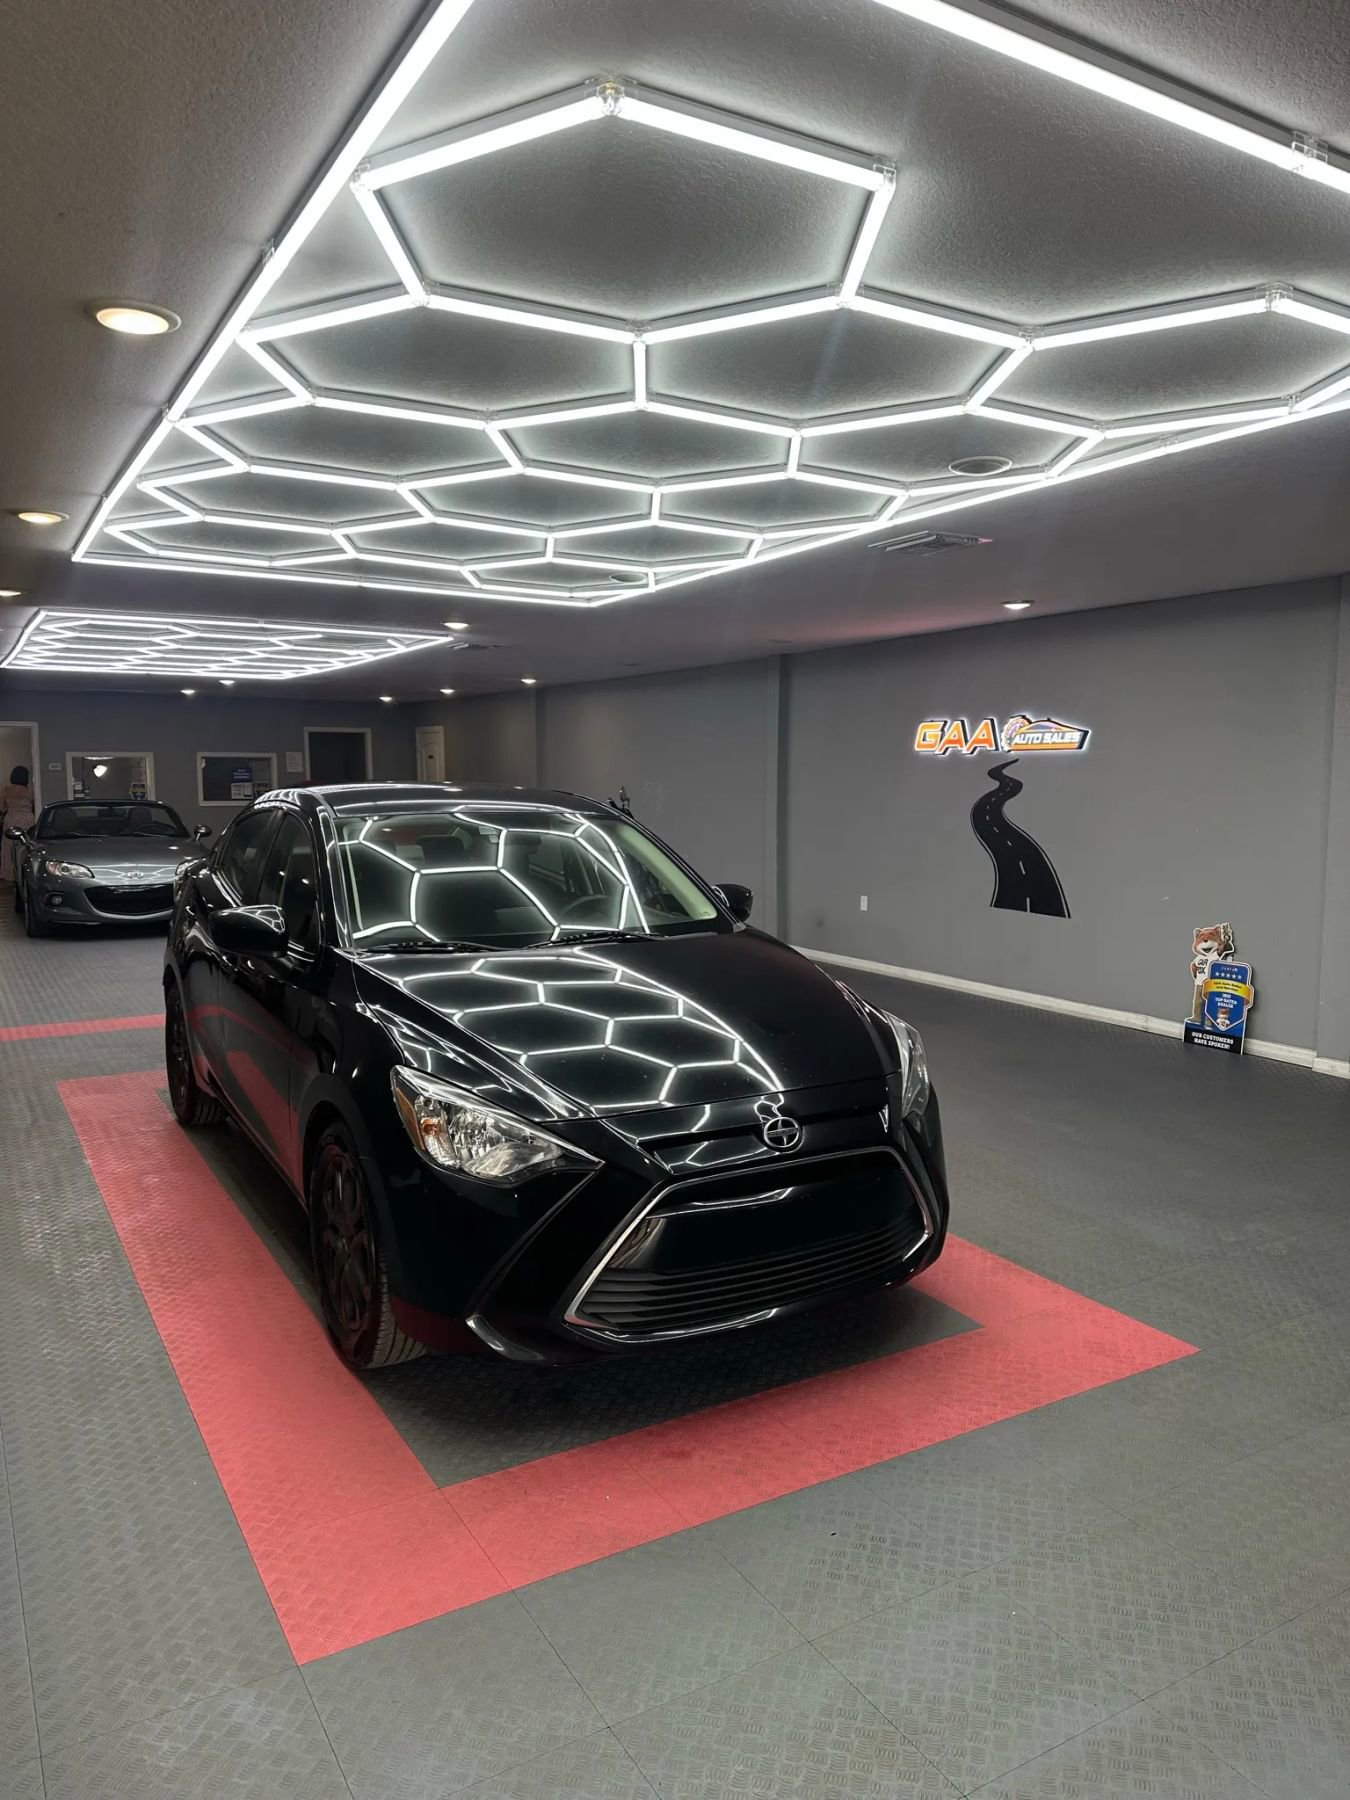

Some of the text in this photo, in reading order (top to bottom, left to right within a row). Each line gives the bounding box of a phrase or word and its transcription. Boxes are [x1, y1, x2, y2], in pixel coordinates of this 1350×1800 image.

[914, 718, 998, 755] GAA
[1014, 731, 1082, 745] AUTO SALES
[1194, 1037, 1208, 1045] HAVE
[1203, 1034, 1234, 1044] CUSTOMERS
